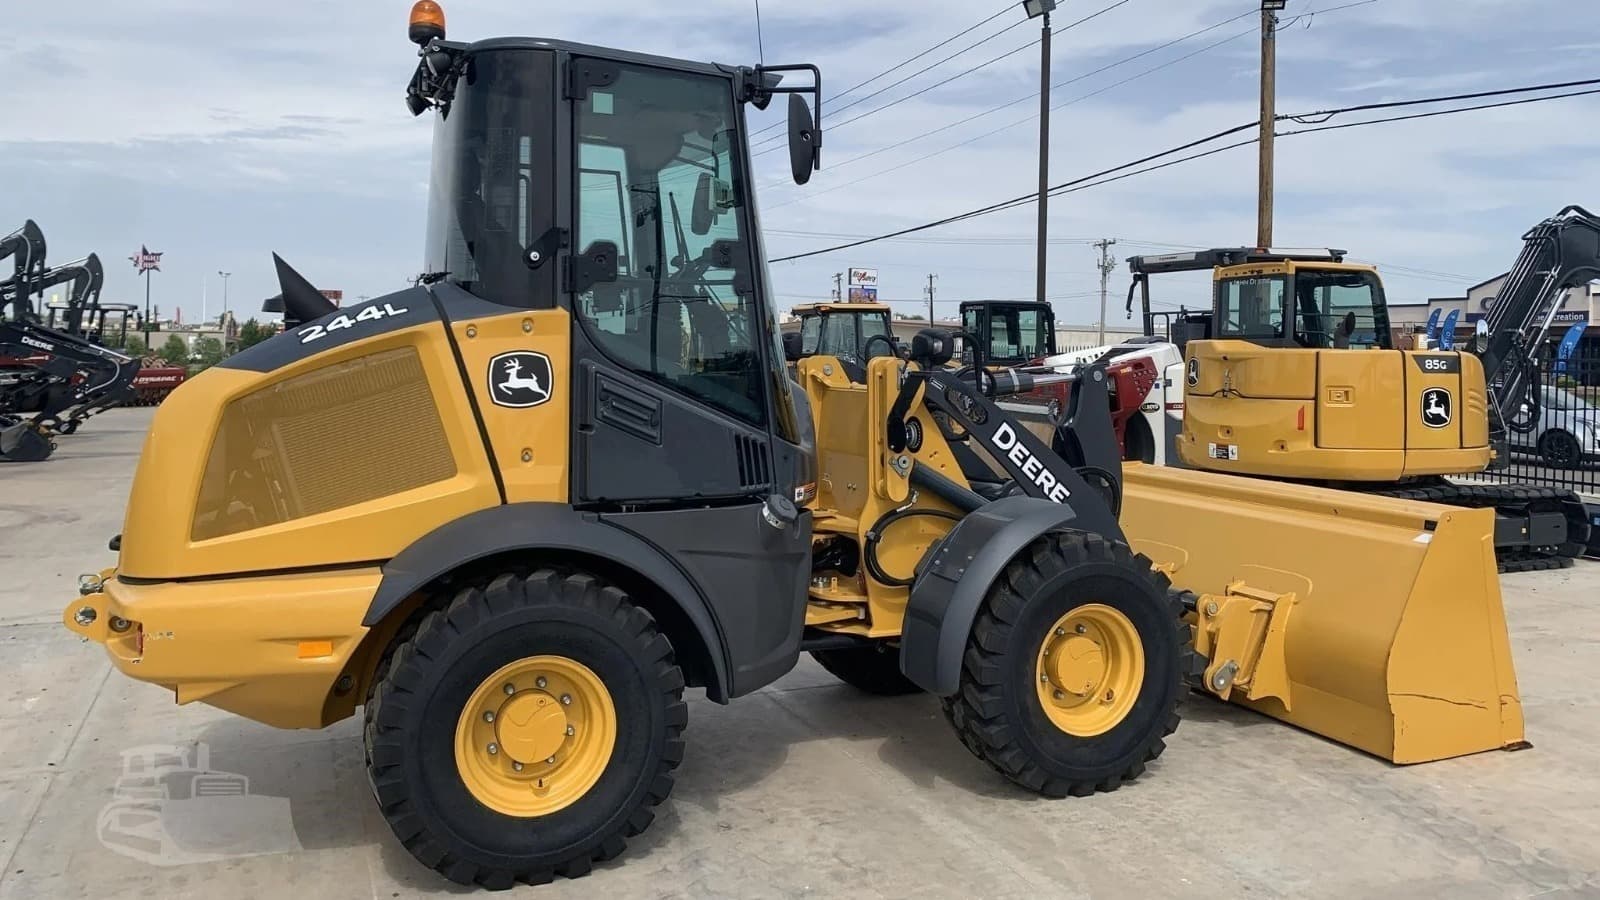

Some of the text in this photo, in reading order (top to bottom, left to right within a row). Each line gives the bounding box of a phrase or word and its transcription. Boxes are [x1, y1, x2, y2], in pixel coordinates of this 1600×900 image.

[298, 303, 408, 344] 244L
[21, 336, 54, 351] DEERE
[1425, 359, 1447, 370] 85G
[991, 421, 1071, 504] DEERE
